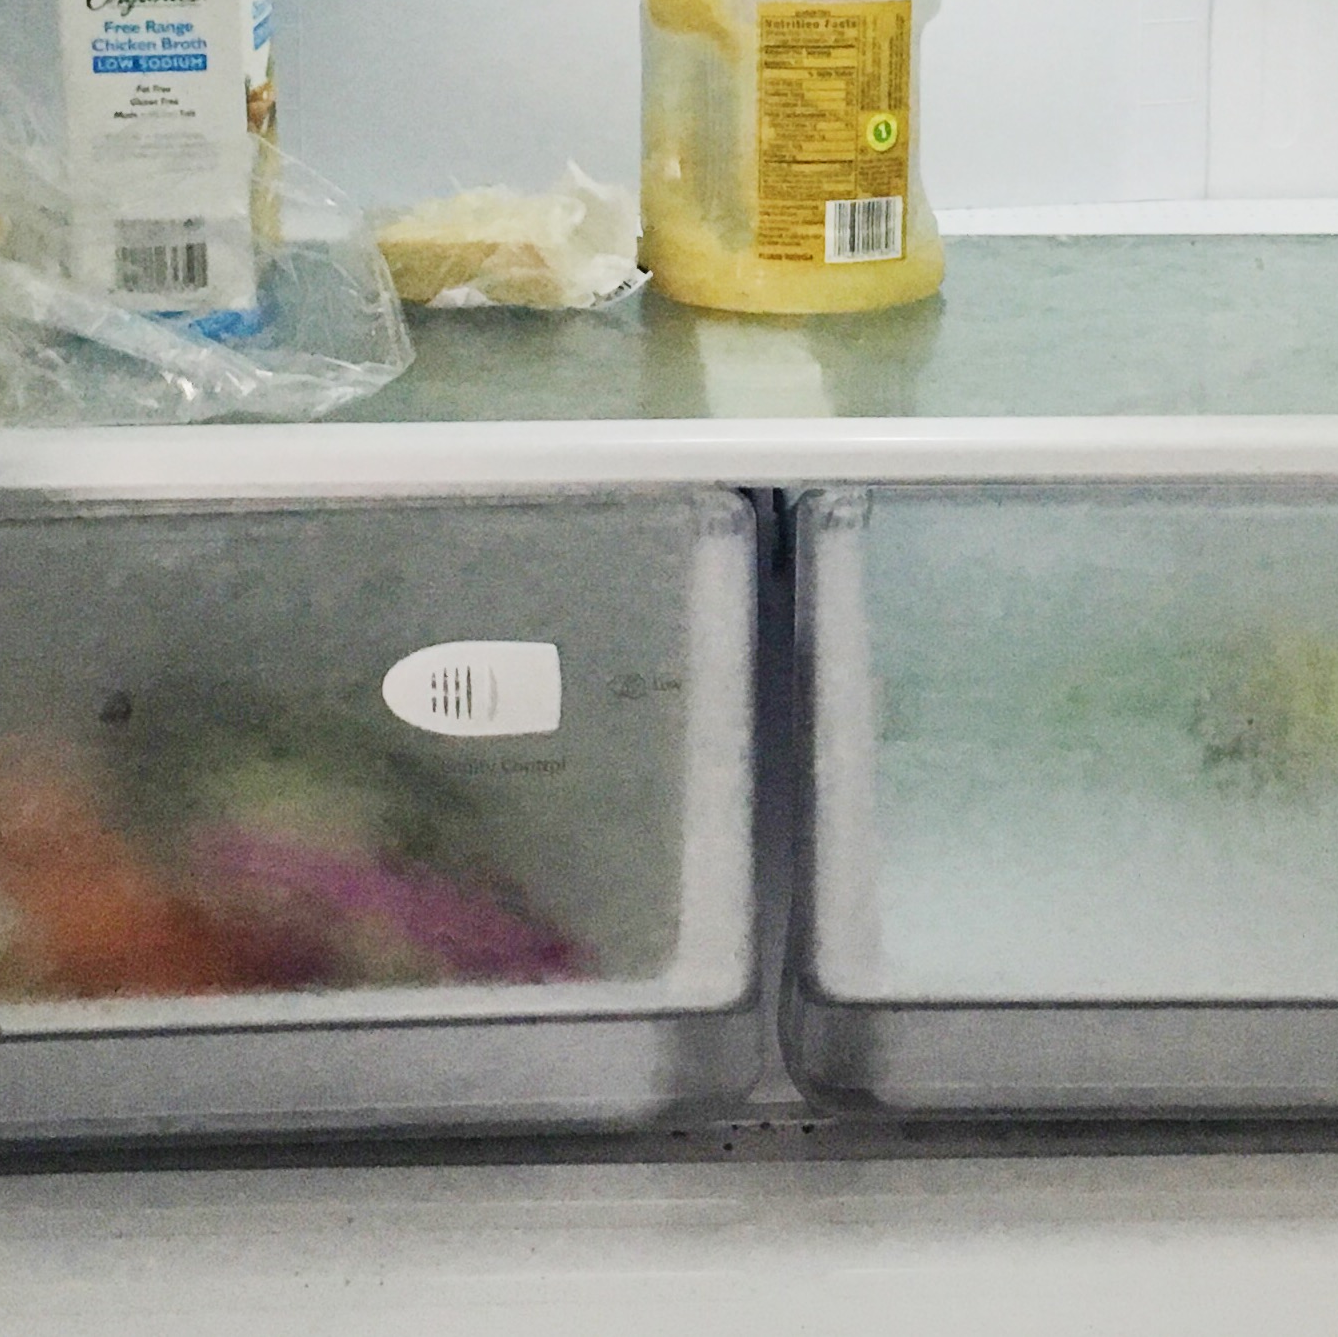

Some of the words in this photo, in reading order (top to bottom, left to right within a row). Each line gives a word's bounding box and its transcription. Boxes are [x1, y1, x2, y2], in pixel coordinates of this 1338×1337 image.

[104, 20, 141, 35] Free
[145, 20, 195, 38] Range
[765, 19, 821, 30] Nutrition
[824, 18, 858, 30] Facts
[91, 37, 158, 53] Chicken
[162, 36, 208, 52] Broth
[97, 57, 135, 71] LOW
[138, 56, 204, 70] SODIUM
